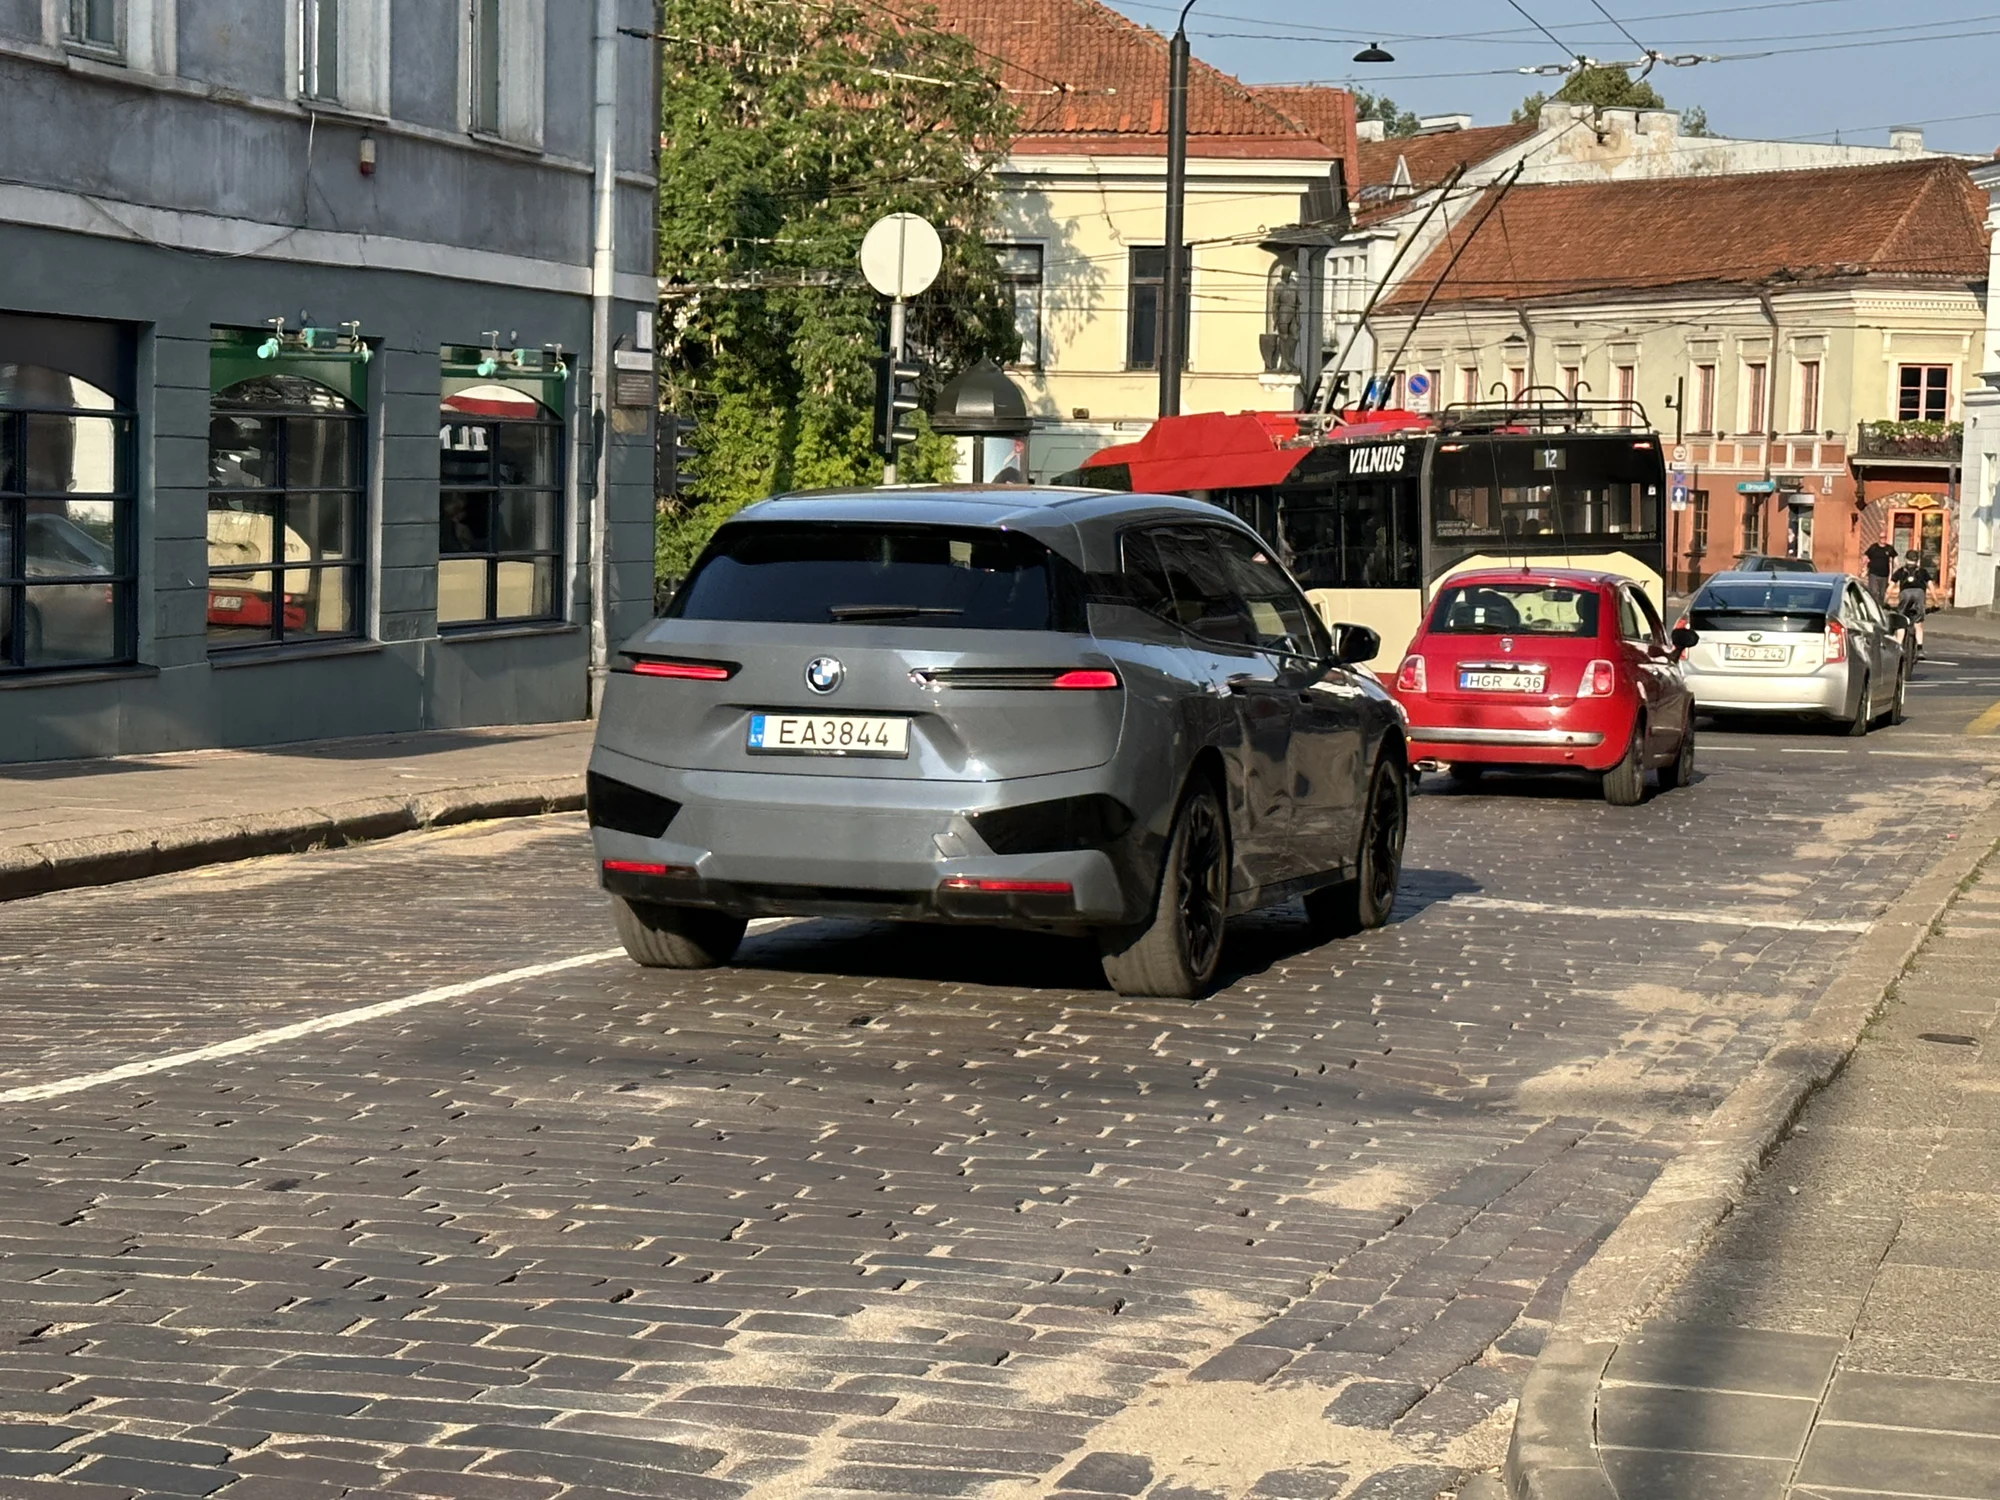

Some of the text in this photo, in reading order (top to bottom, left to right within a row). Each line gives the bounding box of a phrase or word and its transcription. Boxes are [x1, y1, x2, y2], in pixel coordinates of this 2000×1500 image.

[1349, 445, 1405, 474] VILNIUS
[1543, 449, 1558, 469] 12
[1763, 649, 1784, 659] 242
[1470, 675, 1541, 688] HGR 436
[750, 733, 763, 743] LT
[779, 719, 889, 747] EA3844
